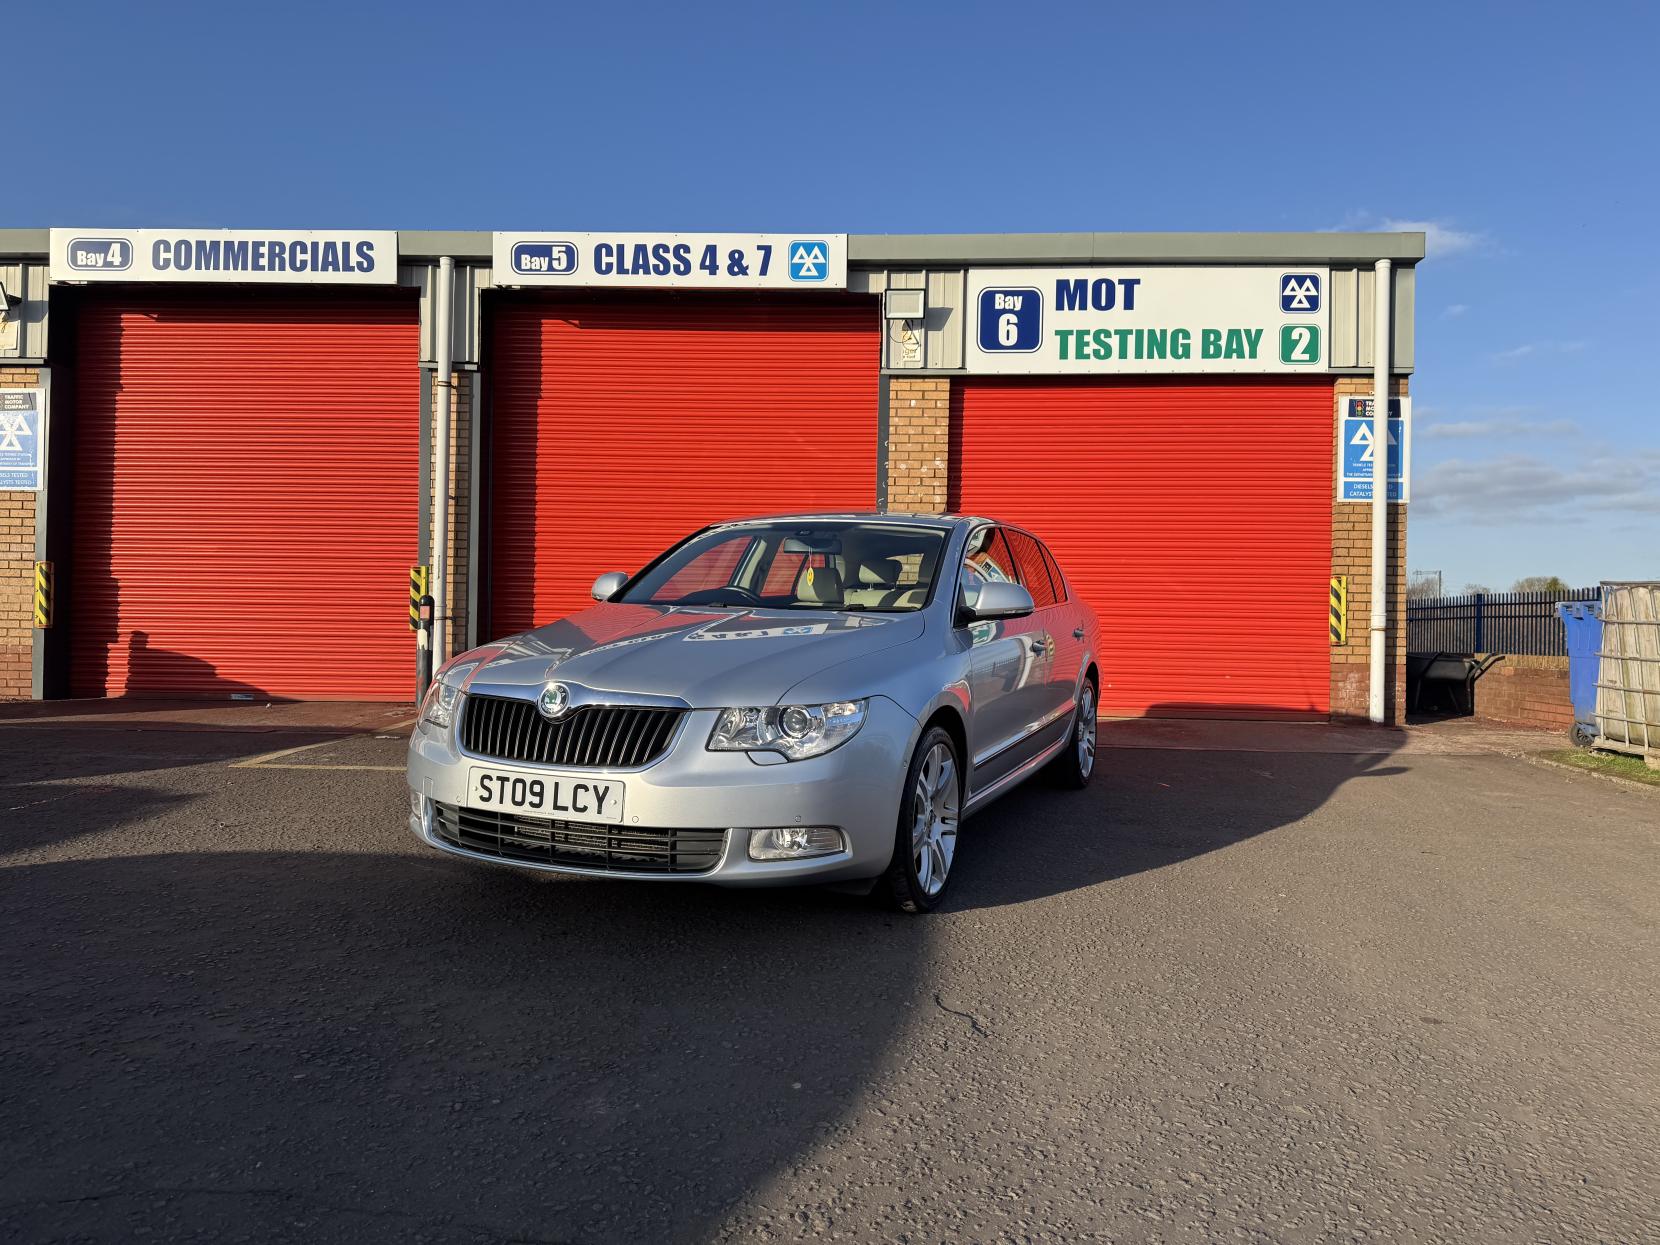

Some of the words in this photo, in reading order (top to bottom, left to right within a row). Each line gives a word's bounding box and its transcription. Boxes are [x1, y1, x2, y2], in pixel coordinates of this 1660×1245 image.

[76, 250, 105, 267] Bay
[106, 243, 122, 266] 4
[152, 239, 375, 273] COMMERCIALS
[521, 254, 549, 272] Bay
[552, 246, 567, 270] 5
[594, 243, 692, 277] CLASS
[699, 244, 719, 276] 4
[727, 249, 750, 276] &
[756, 245, 773, 276] 7
[994, 293, 1023, 312] Bay
[1055, 278, 1141, 311] MOT
[998, 313, 1018, 347] 6
[1055, 328, 1192, 361] TESTING
[1201, 328, 1264, 360] BAY
[1290, 327, 1310, 361] 2
[479, 774, 545, 809] ST09
[552, 781, 610, 815] LCY
